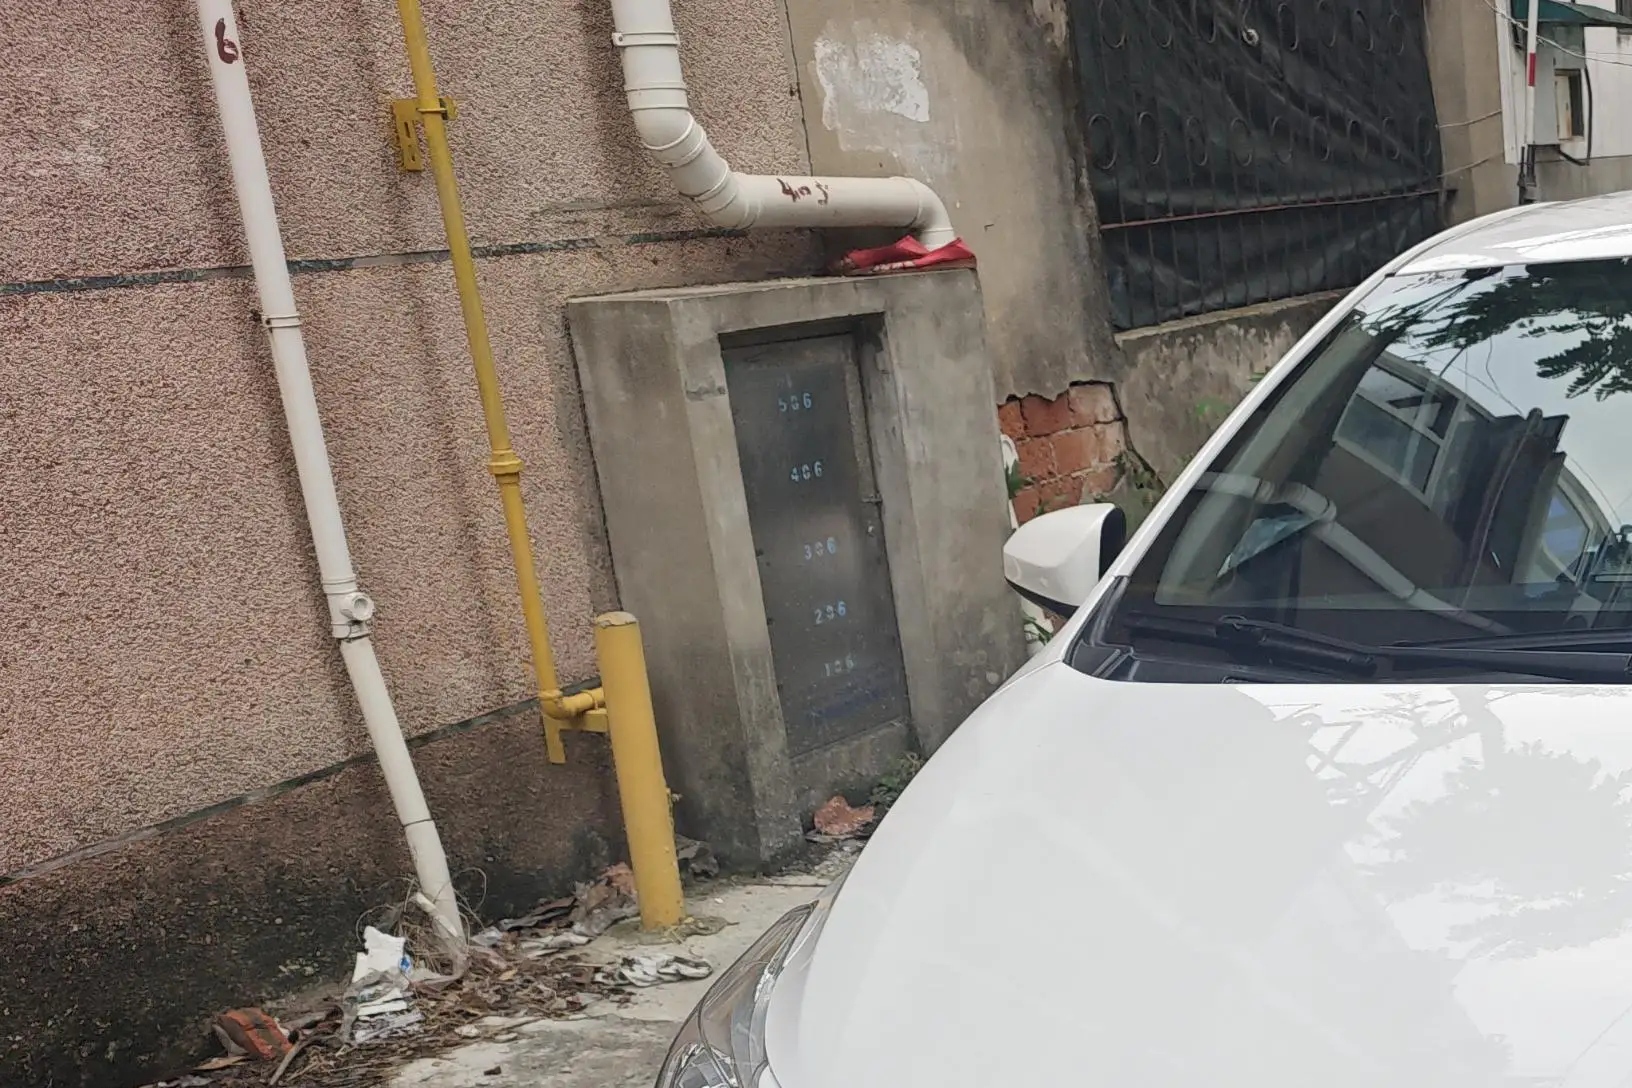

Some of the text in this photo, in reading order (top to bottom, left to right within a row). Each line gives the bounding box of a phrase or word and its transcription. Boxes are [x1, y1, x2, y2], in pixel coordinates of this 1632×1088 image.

[778, 392, 812, 412] 506
[790, 460, 823, 482] 406
[804, 536, 836, 560] 306
[814, 600, 846, 625] 206
